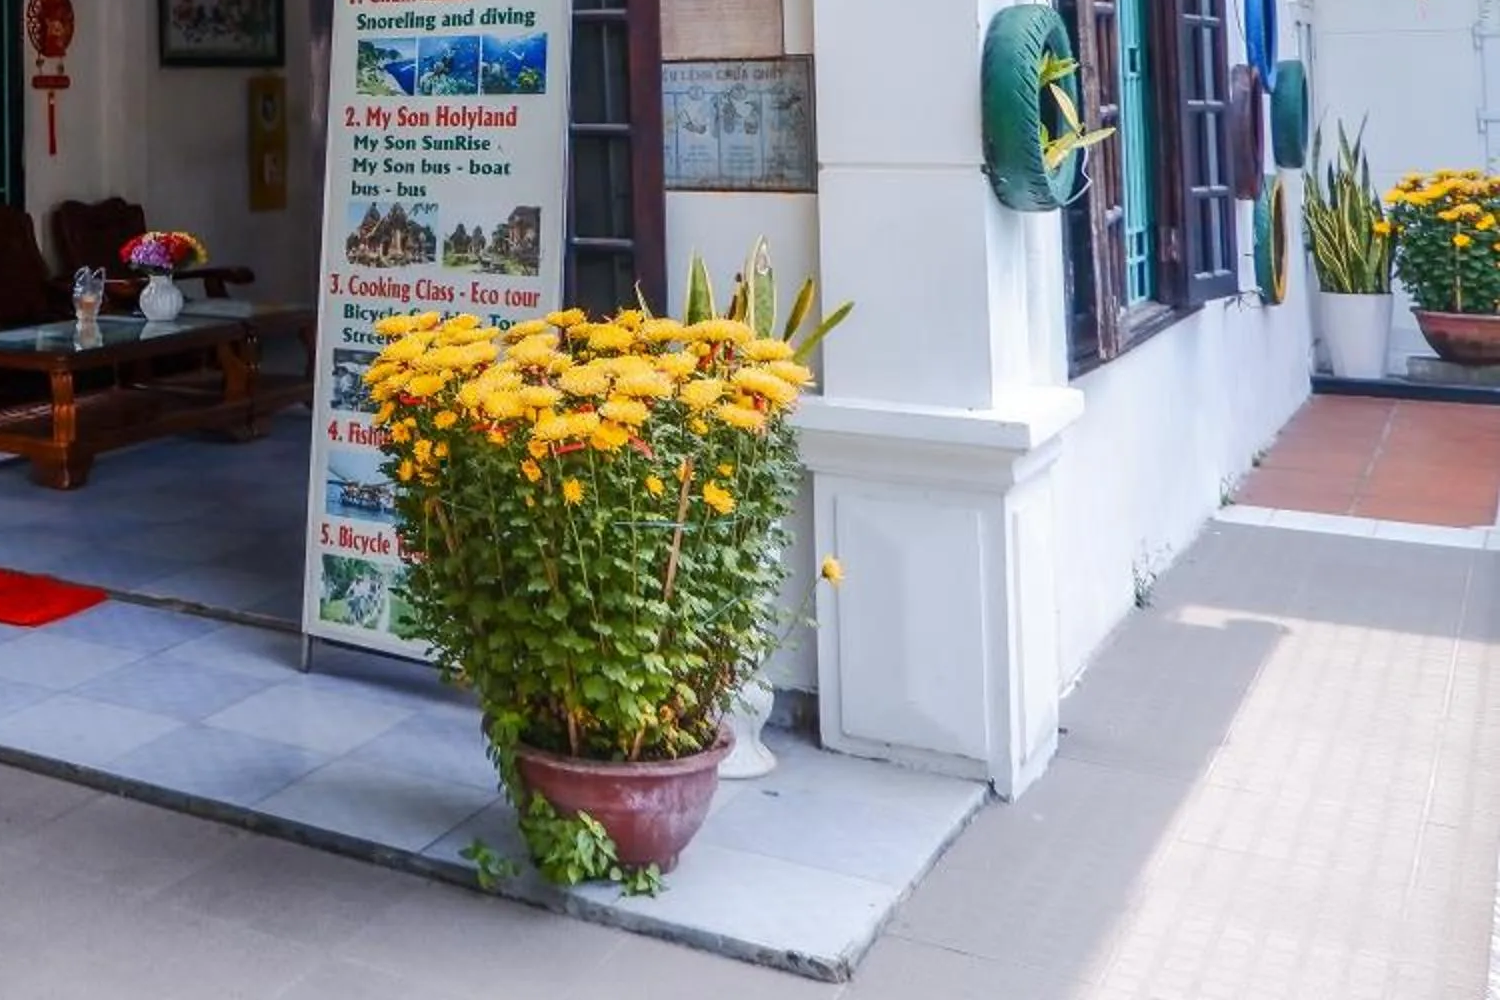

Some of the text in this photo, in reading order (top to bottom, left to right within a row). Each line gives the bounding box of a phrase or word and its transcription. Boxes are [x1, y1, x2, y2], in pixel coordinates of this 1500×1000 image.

[441, 8, 474, 27] and
[479, 7, 536, 27] diving
[345, 106, 517, 130] 2. My Son Holyland
[353, 136, 491, 151] My Son SunRise
[352, 158, 378, 174] My
[383, 158, 415, 174] Son
[421, 159, 451, 174] bus
[470, 160, 511, 175] boat
[351, 181, 379, 197] bus
[397, 182, 426, 197] bus
[330, 274, 343, 294] 3.
[349, 276, 410, 302] Cooking
[415, 279, 454, 302] Class
[471, 282, 498, 305] Eco
[504, 286, 541, 308] tour
[328, 421, 343, 441] 4.
[321, 523, 334, 545] 5.
[339, 526, 390, 554] Bicycle
